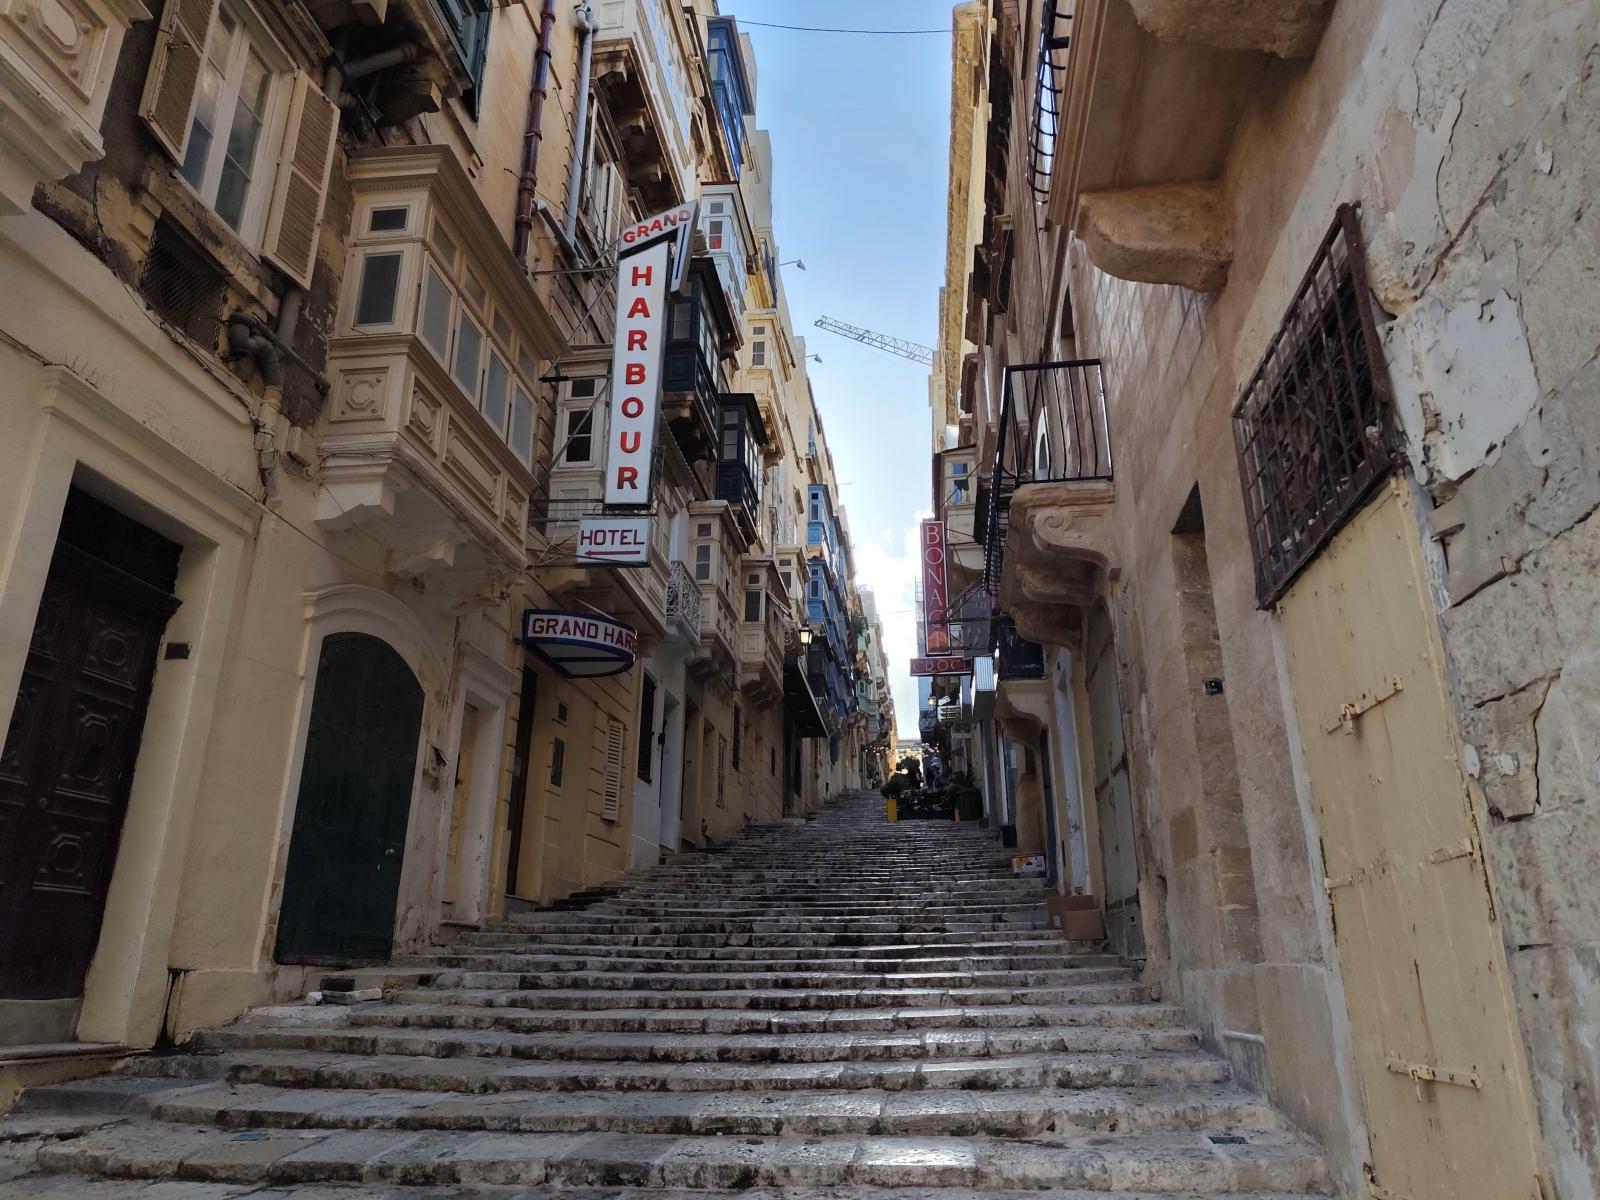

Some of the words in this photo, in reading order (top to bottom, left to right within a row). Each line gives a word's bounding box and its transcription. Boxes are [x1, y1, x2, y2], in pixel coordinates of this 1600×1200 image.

[623, 209, 692, 243] GRAND
[616, 265, 654, 490] HARBOUR
[580, 528, 645, 546] HOTEL
[531, 617, 600, 639] GRAND
